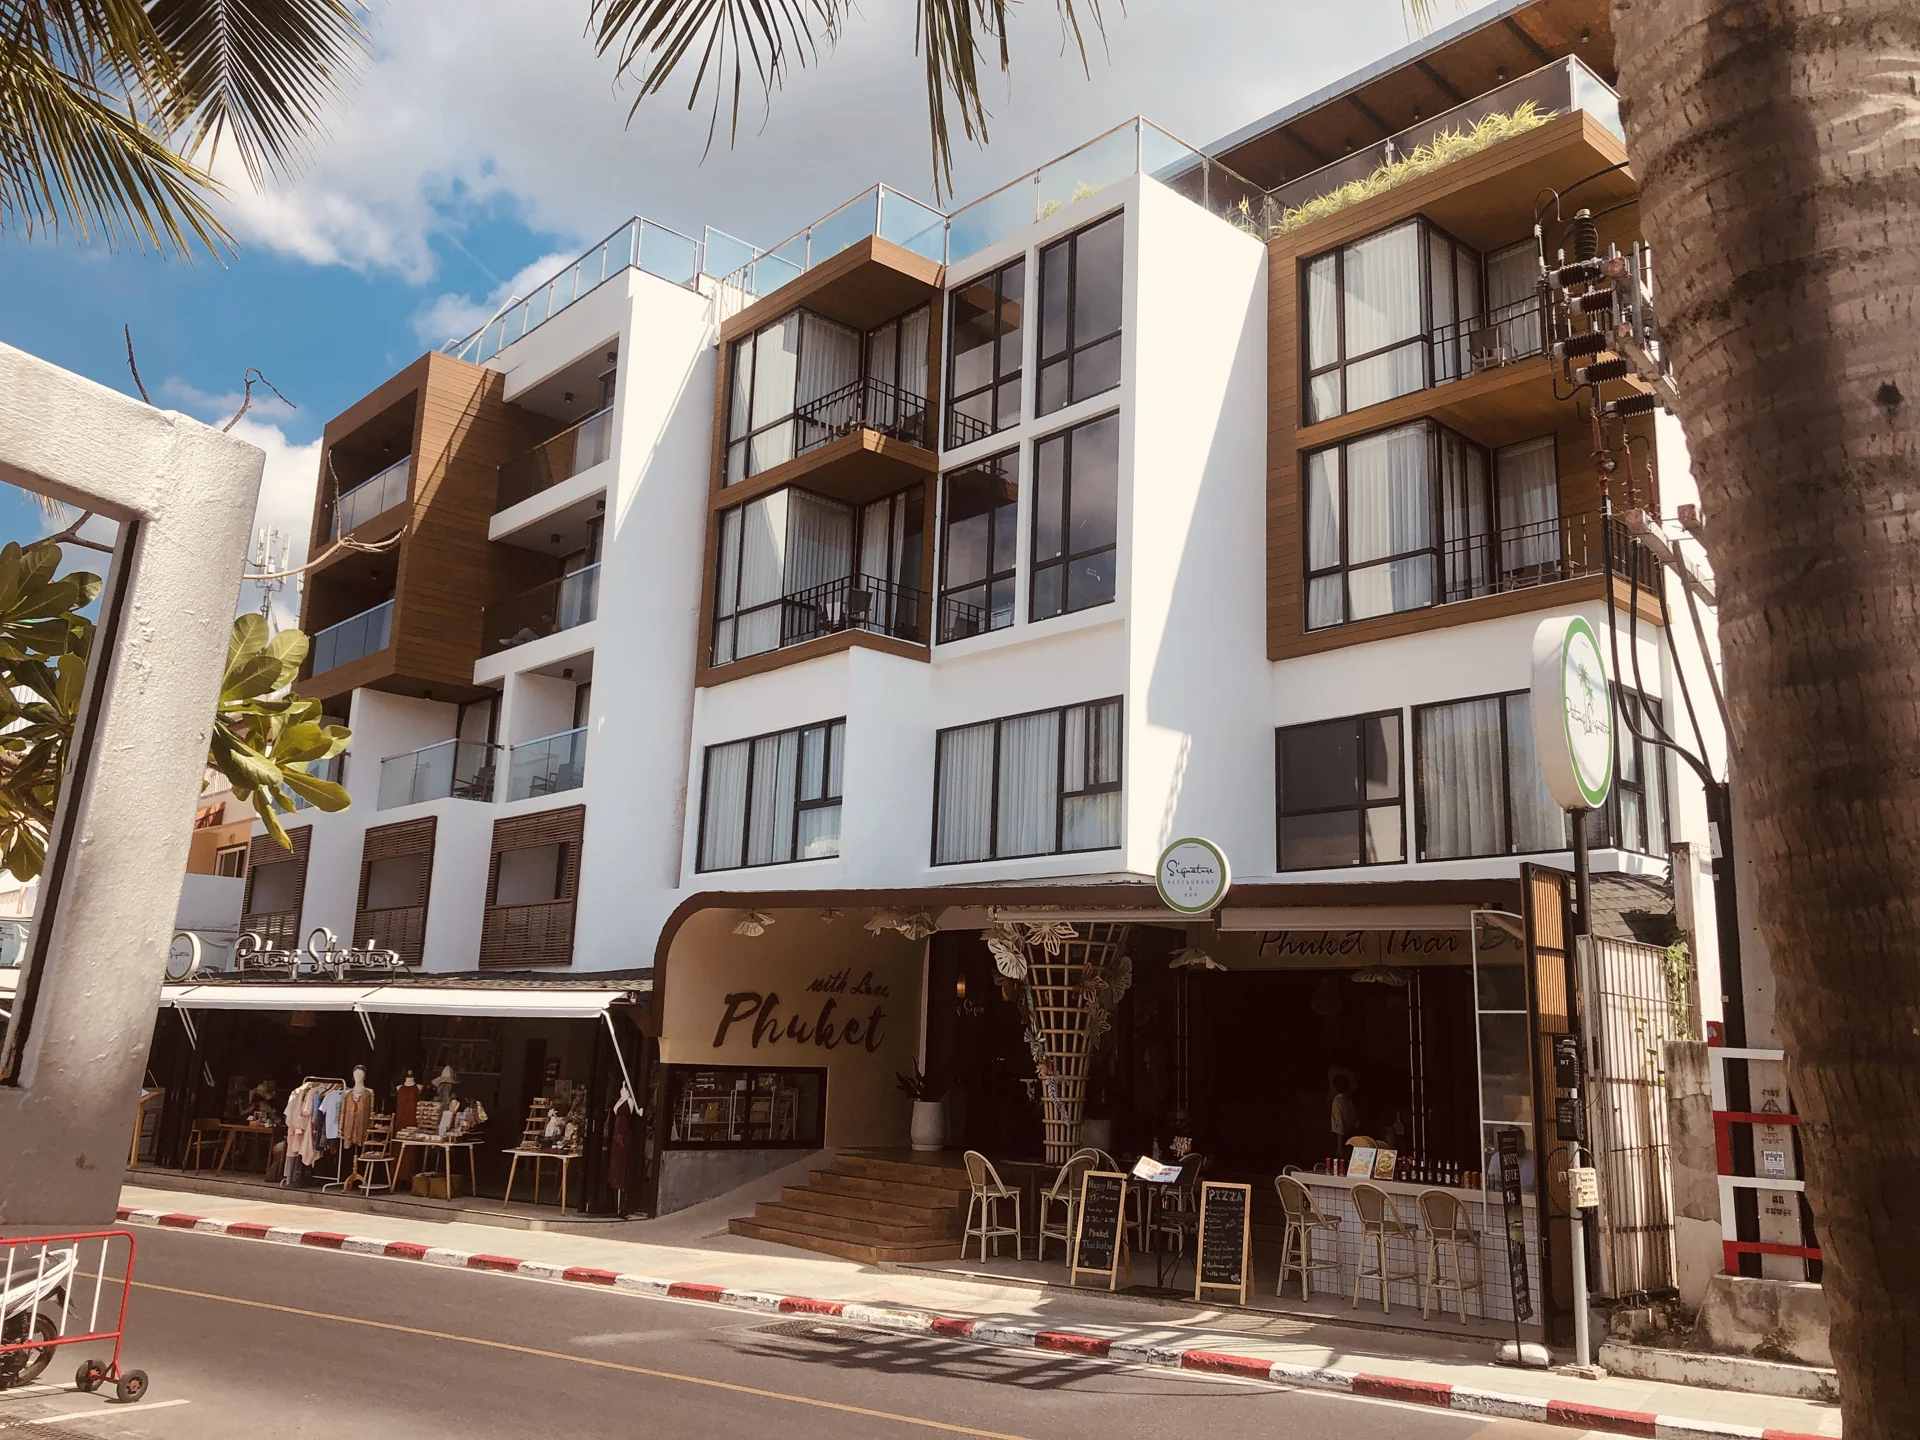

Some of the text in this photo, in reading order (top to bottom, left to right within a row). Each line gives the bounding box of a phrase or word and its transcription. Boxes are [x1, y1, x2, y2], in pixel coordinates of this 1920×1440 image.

[1166, 859, 1215, 878] Signature
[233, 927, 404, 980] Patong Signature
[713, 992, 888, 1053] Phuket
[1172, 1135, 1192, 1144] JUST
[1208, 1189, 1243, 1202] PIZZA
